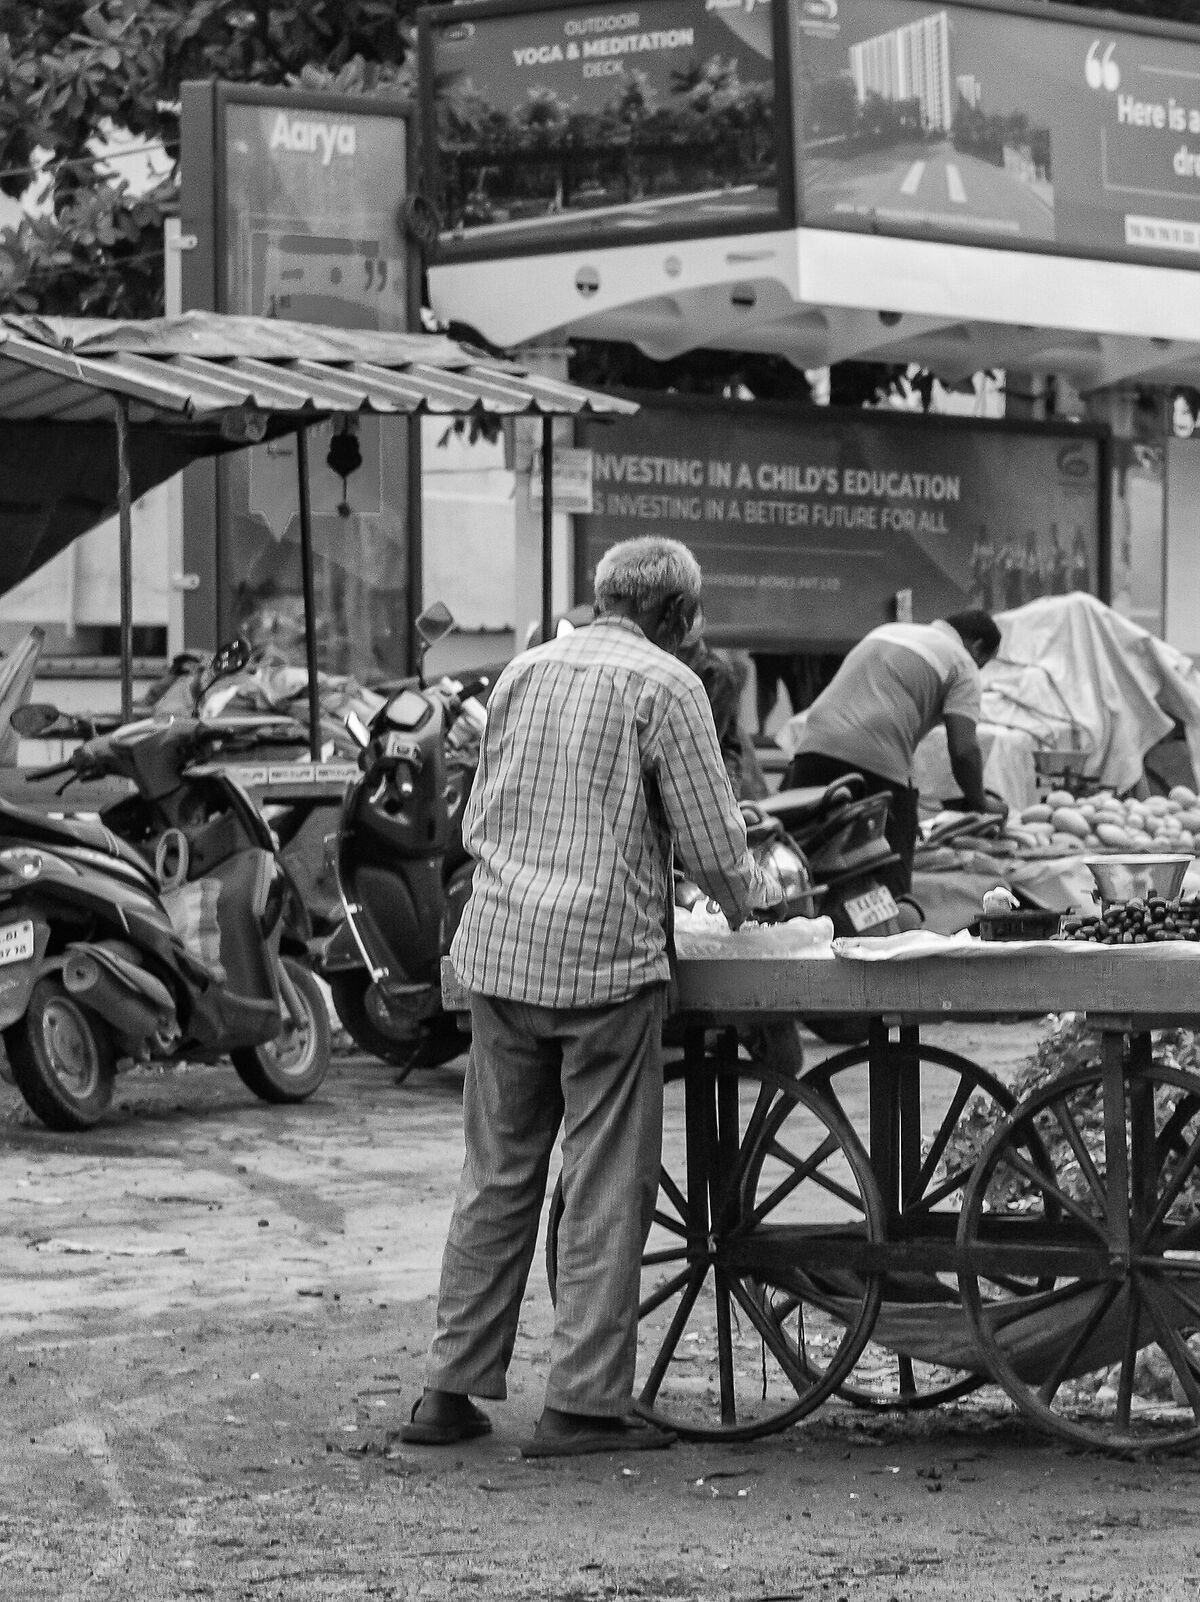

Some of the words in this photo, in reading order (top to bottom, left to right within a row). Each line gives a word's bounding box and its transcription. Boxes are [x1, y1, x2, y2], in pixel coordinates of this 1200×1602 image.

[564, 12, 640, 36] OUTDOOR
[512, 45, 564, 67] YOGA
[566, 41, 581, 61] &
[582, 27, 695, 58] MEDITATION
[582, 59, 624, 79] DECK
[1117, 94, 1166, 129] Here
[1168, 98, 1187, 132] is
[269, 112, 357, 166] Aarya
[593, 453, 703, 487] NVESTING
[707, 460, 732, 488] IN
[735, 463, 754, 490] A
[757, 463, 840, 495] CHILD'S
[843, 468, 961, 501] EDUCATION
[606, 493, 702, 521] INVESTING
[704, 499, 725, 521] IN
[727, 500, 742, 521] A
[744, 501, 810, 527] BETTER
[811, 503, 878, 530] FUTURE
[880, 507, 917, 532] FOR
[918, 510, 950, 535] ALL
